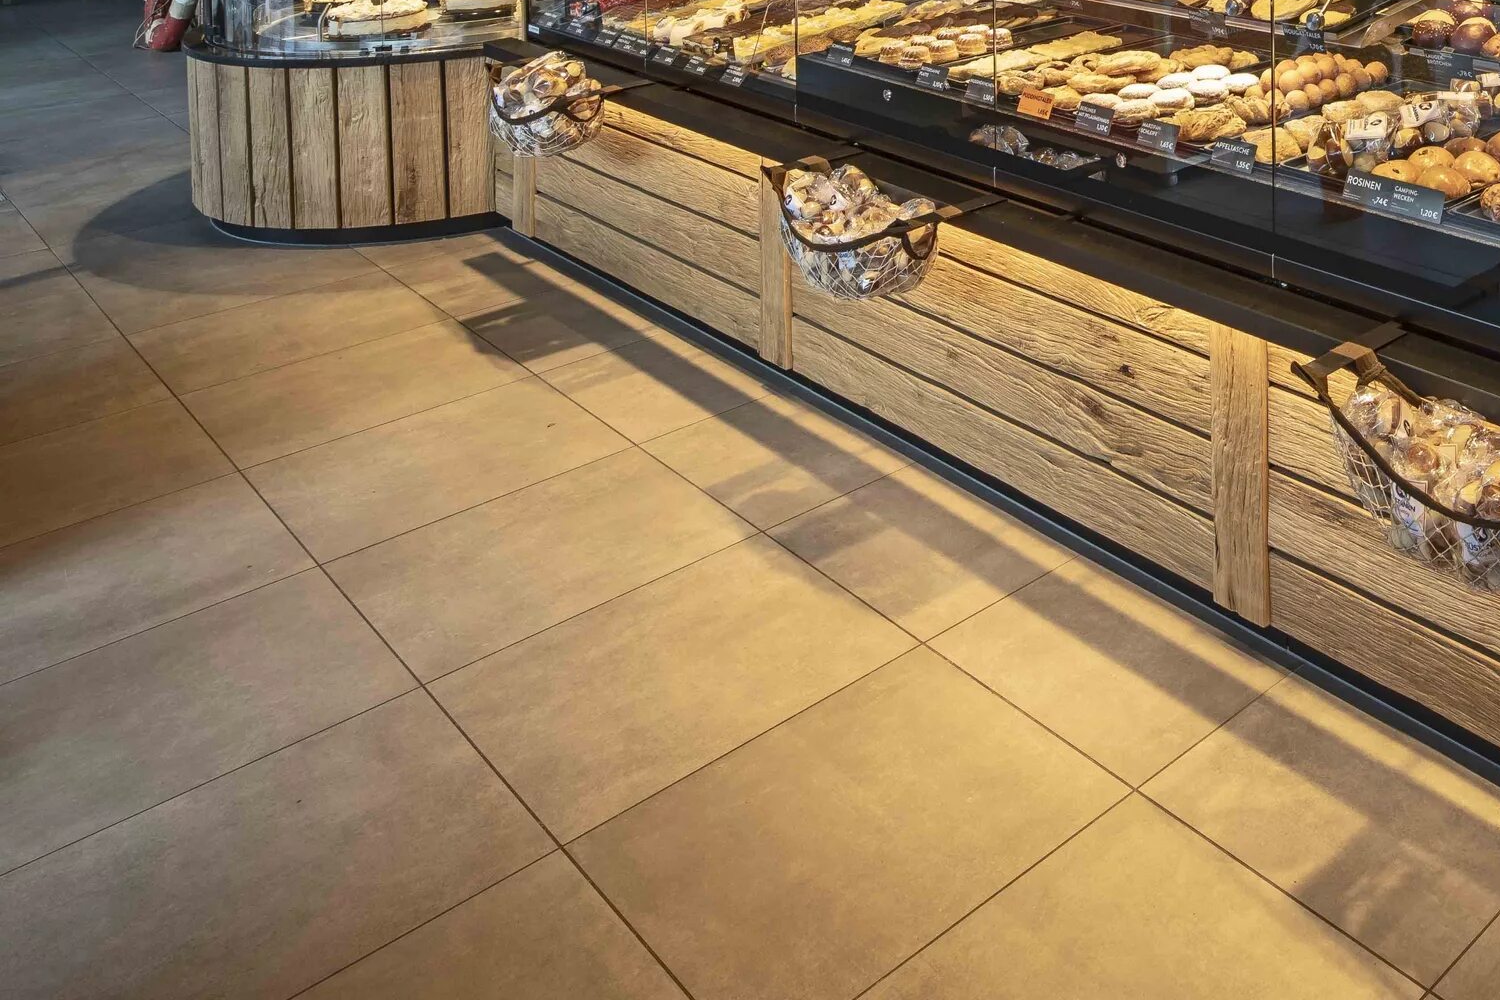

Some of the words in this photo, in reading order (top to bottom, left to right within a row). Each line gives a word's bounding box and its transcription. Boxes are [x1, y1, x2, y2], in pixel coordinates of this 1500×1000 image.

[1215, 141, 1251, 155] APFELTASCHE
[1346, 175, 1382, 192] ROSINEN
[1393, 193, 1415, 203] WECKEN
